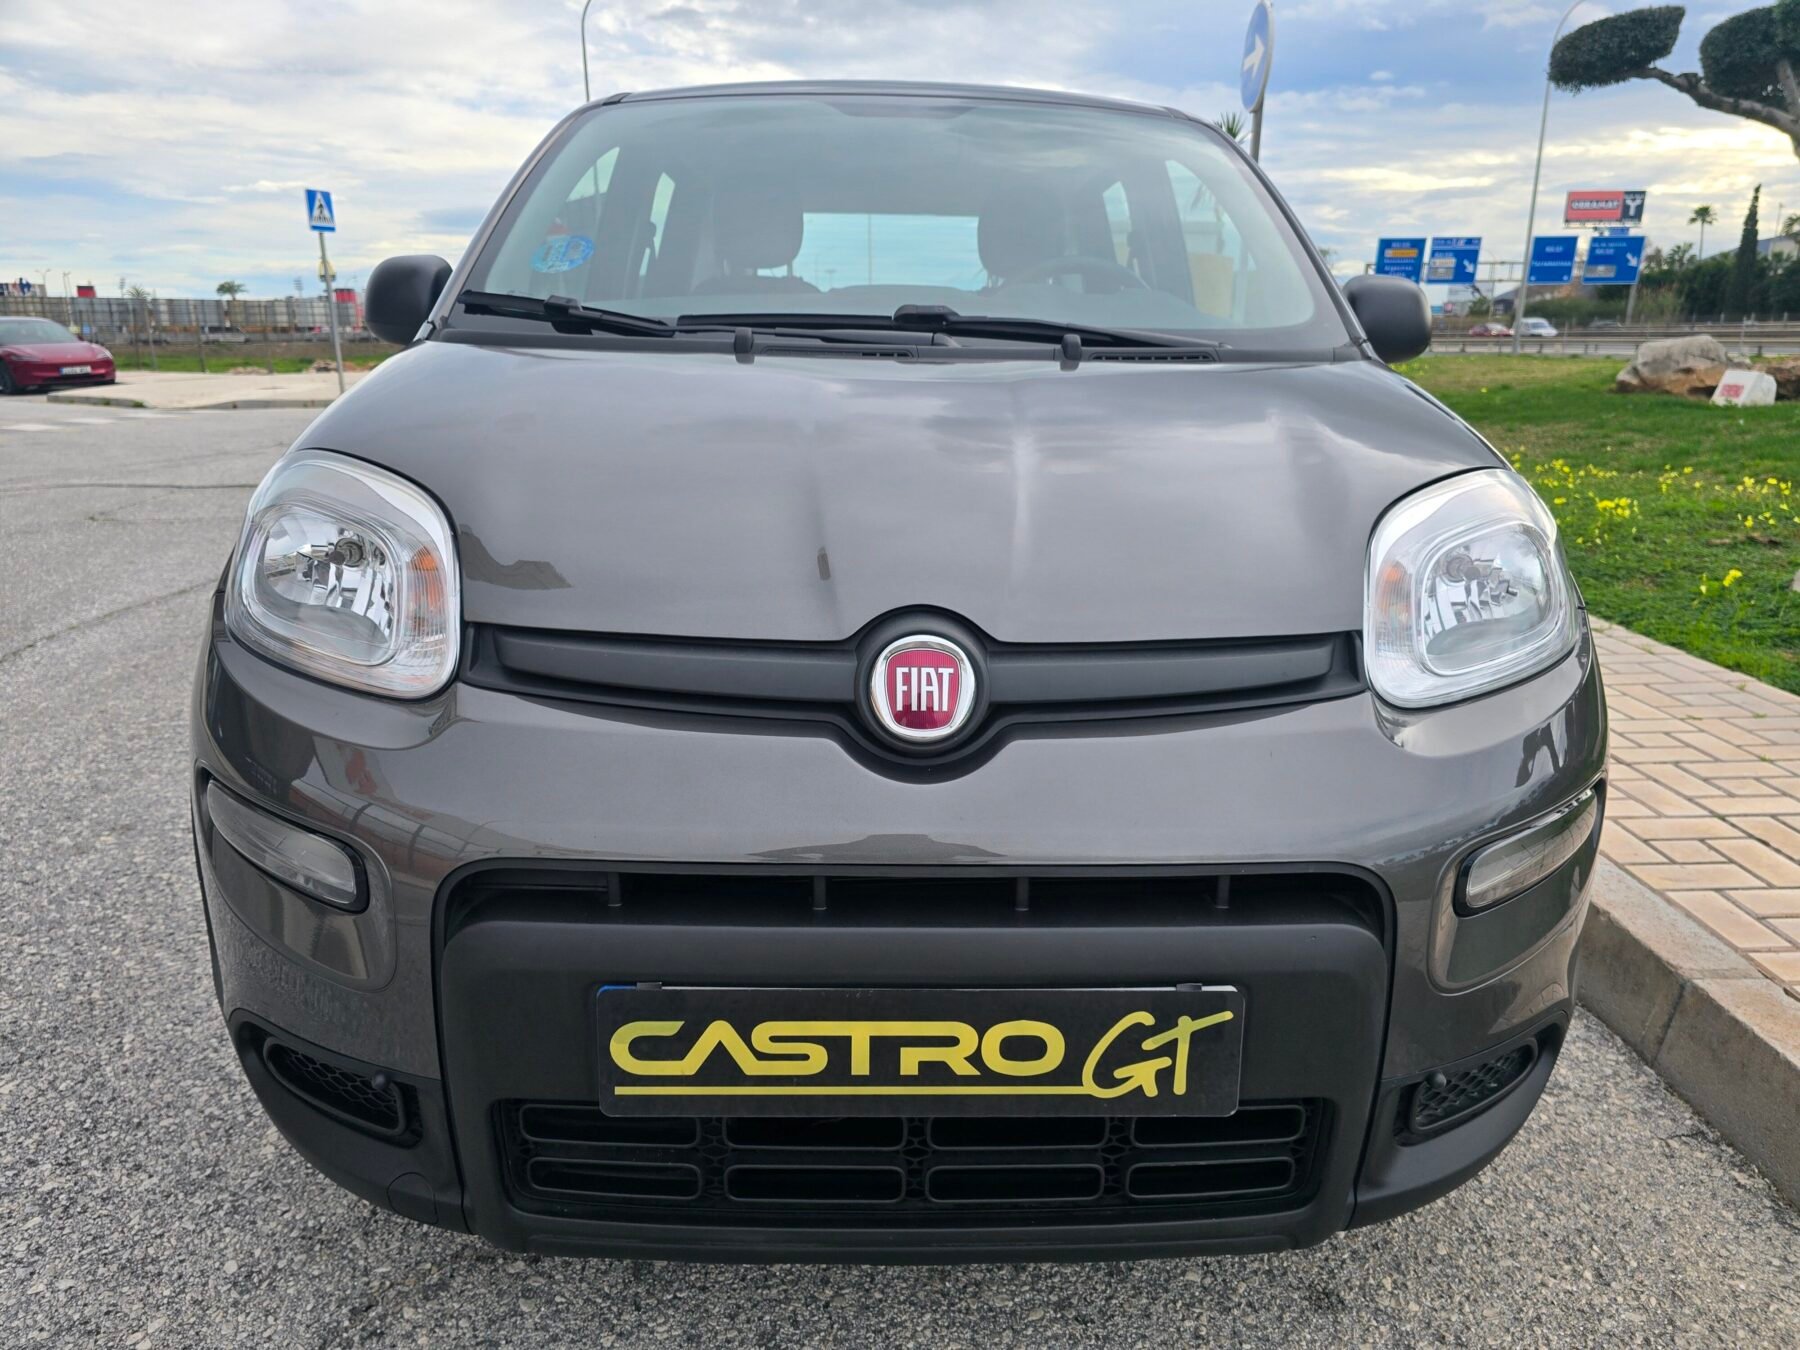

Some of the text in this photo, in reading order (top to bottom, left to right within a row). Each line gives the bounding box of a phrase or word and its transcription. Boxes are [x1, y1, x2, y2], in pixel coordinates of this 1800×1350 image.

[895, 666, 954, 712] FIAT
[609, 1010, 1234, 1099] CASTRO GT
